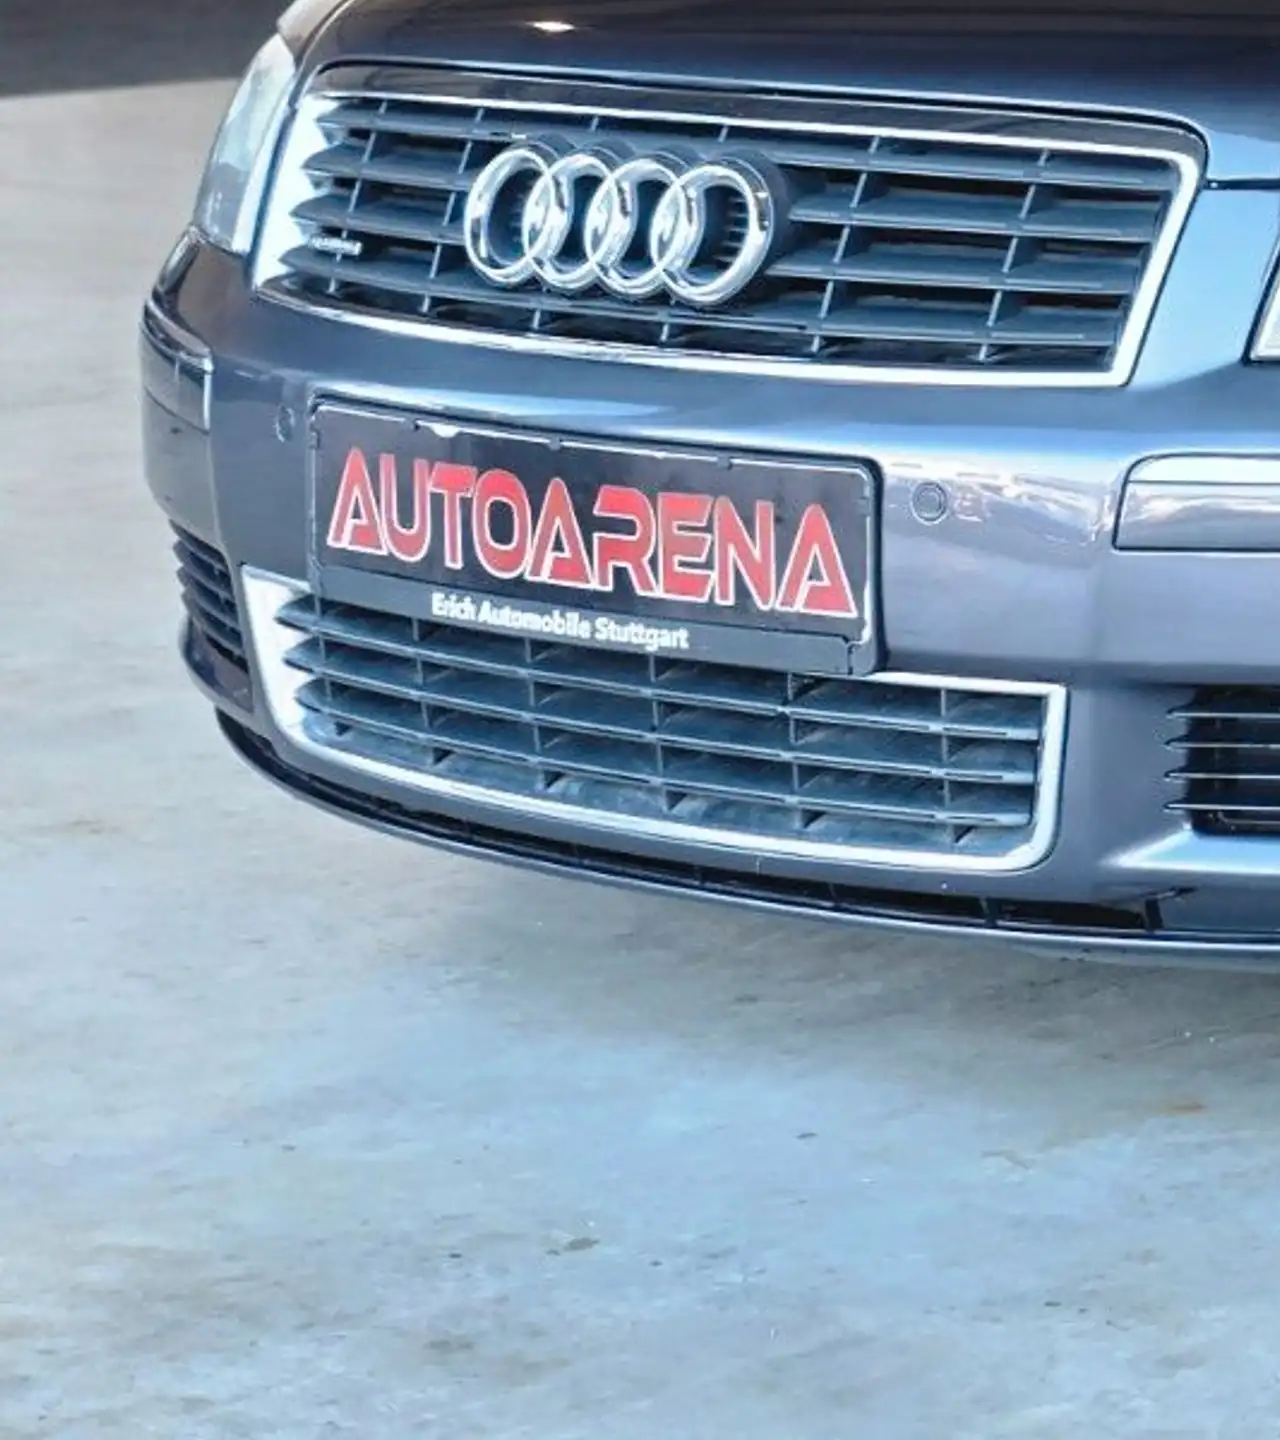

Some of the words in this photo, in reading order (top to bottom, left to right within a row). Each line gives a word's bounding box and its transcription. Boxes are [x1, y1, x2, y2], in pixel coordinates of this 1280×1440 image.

[327, 447, 858, 618] AUTOARENA
[431, 592, 478, 621] Erich
[477, 601, 592, 639] Automobile
[595, 616, 690, 652] Stuttgart
